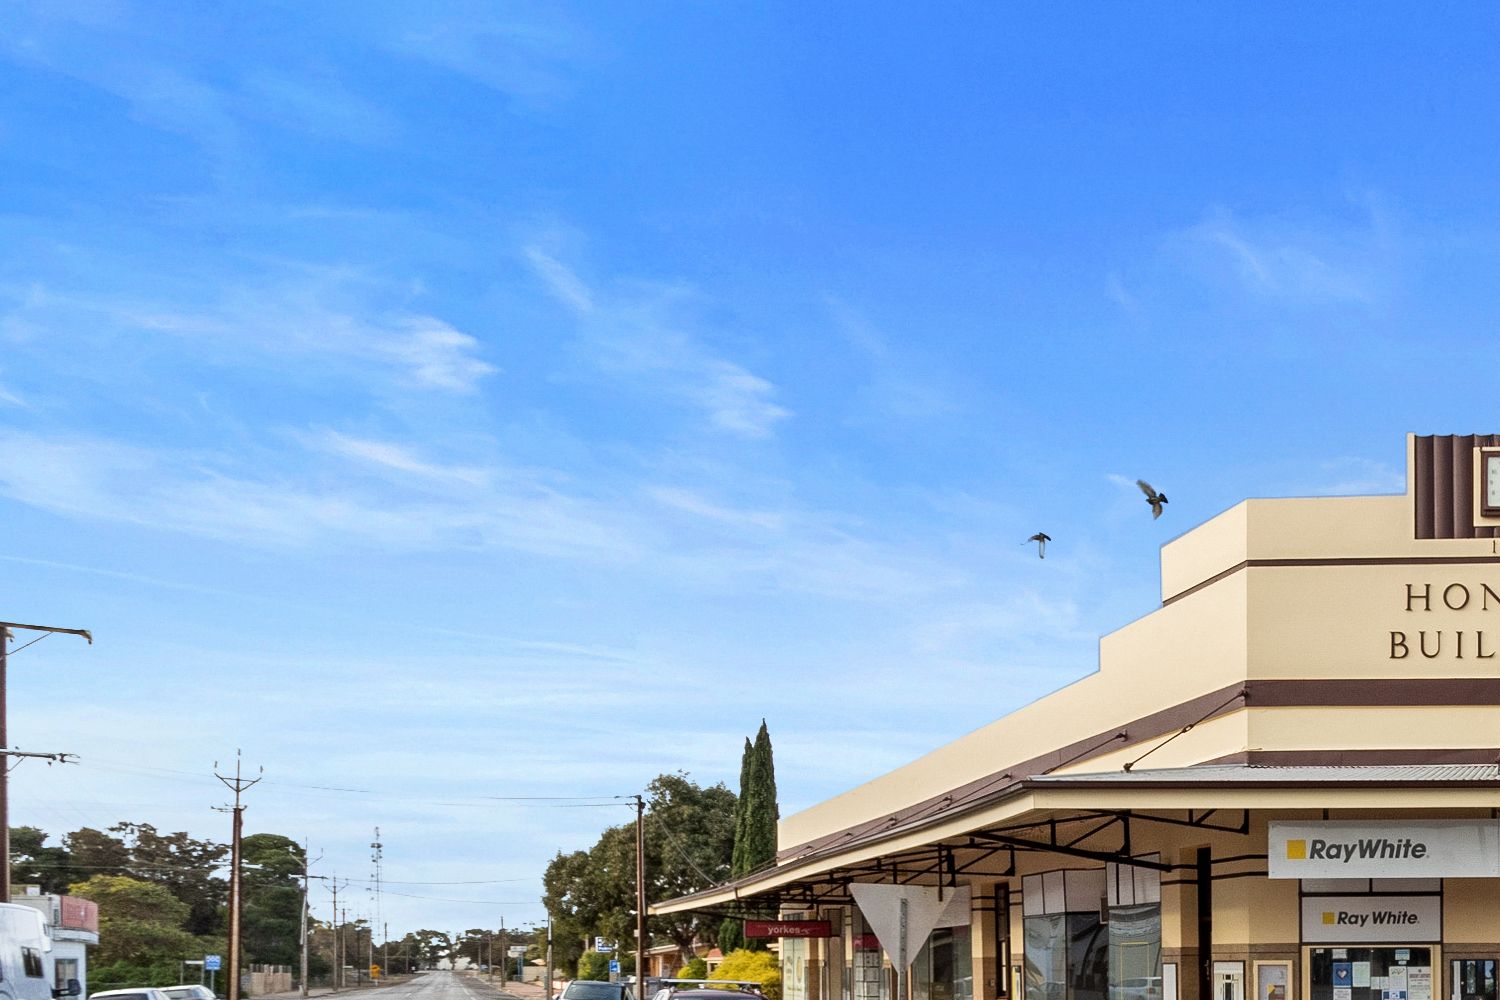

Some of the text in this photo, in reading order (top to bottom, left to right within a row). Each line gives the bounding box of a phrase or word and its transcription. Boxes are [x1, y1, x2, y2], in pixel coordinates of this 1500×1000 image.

[1337, 910, 1418, 928] Ray White
[767, 924, 801, 936] yorkes
